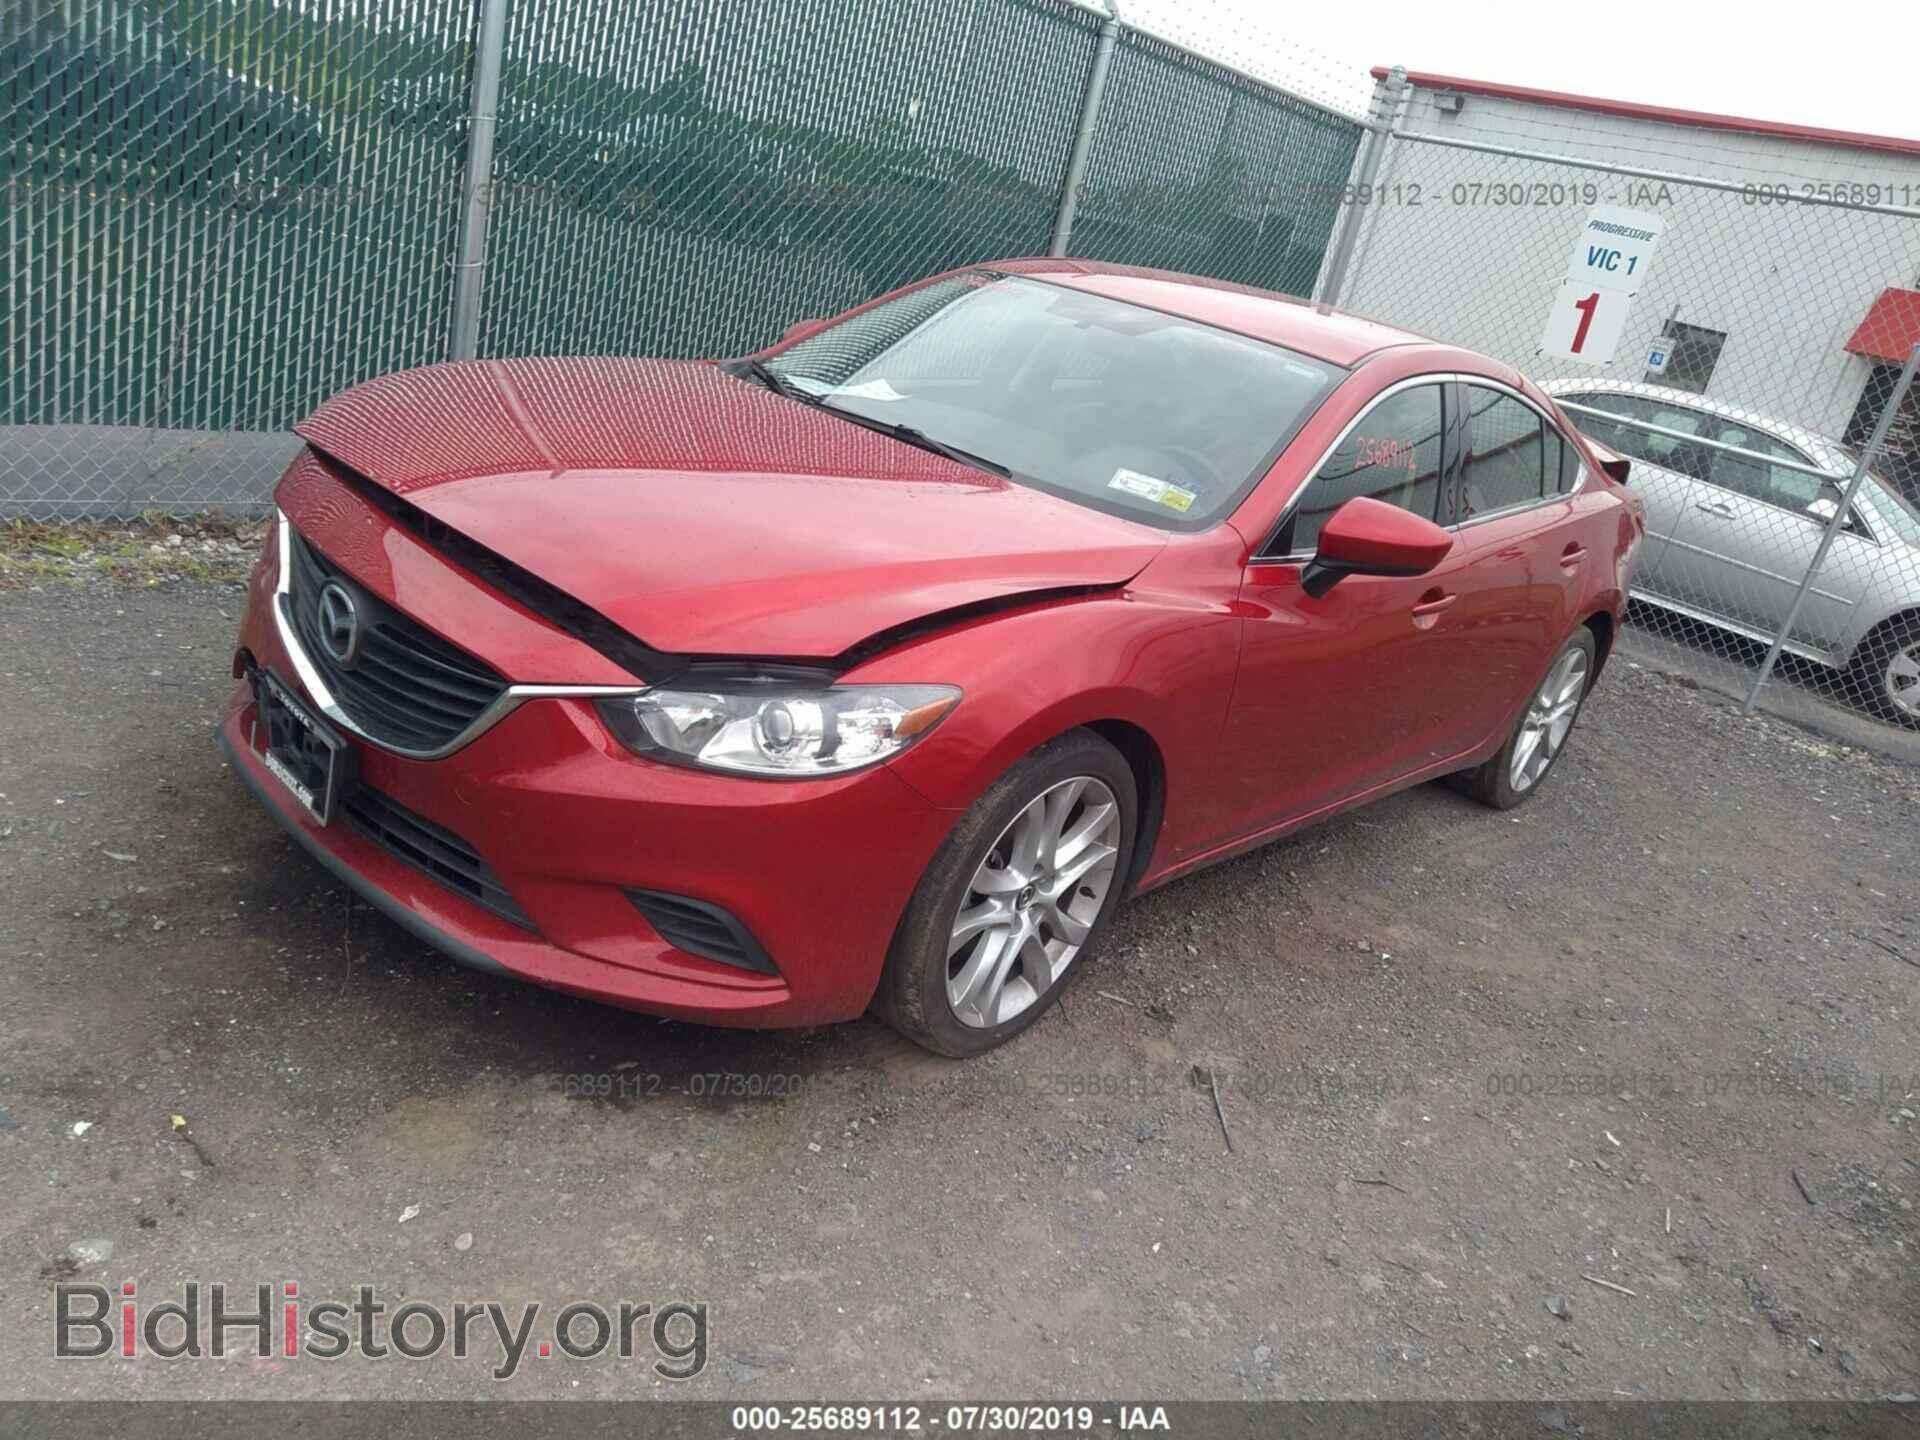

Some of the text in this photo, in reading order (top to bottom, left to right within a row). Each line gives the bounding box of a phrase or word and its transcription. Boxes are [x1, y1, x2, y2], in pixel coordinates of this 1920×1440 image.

[1588, 219, 1657, 242] PROGRESSIVE
[1587, 246, 1638, 276] VIC 1
[1570, 292, 1600, 354] 1
